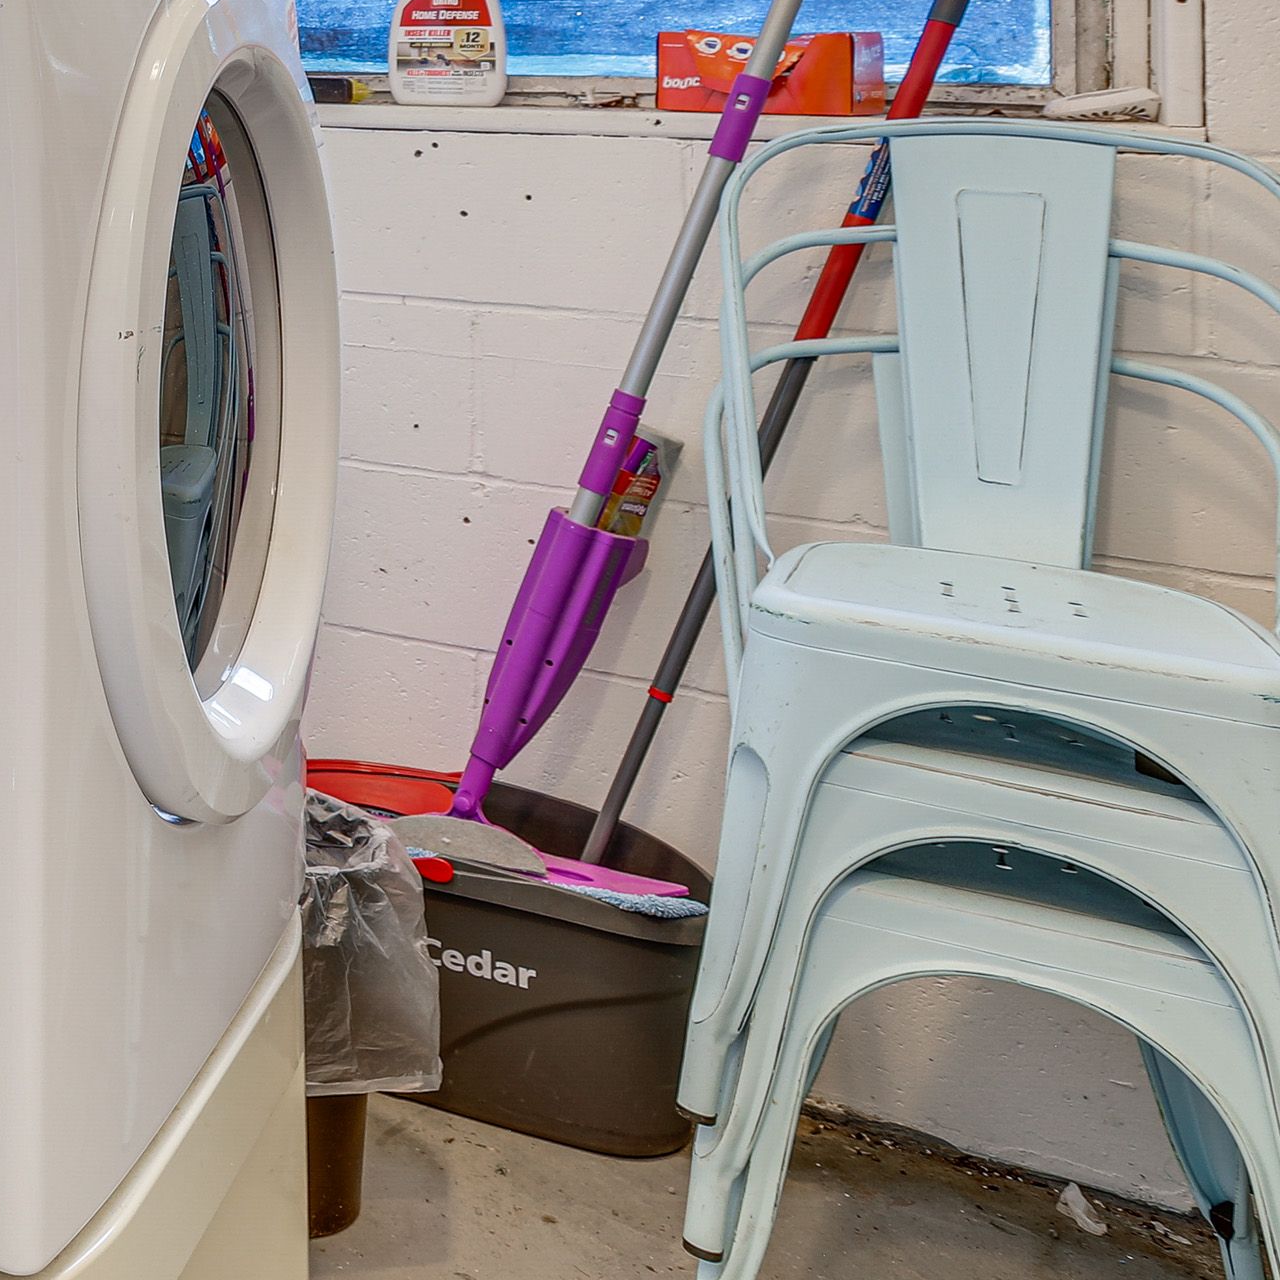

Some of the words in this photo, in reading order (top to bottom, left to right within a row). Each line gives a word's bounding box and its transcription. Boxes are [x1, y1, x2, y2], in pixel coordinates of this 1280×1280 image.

[465, 32, 480, 43] 12
[662, 76, 701, 89] bounc
[422, 936, 537, 989] Cedar
